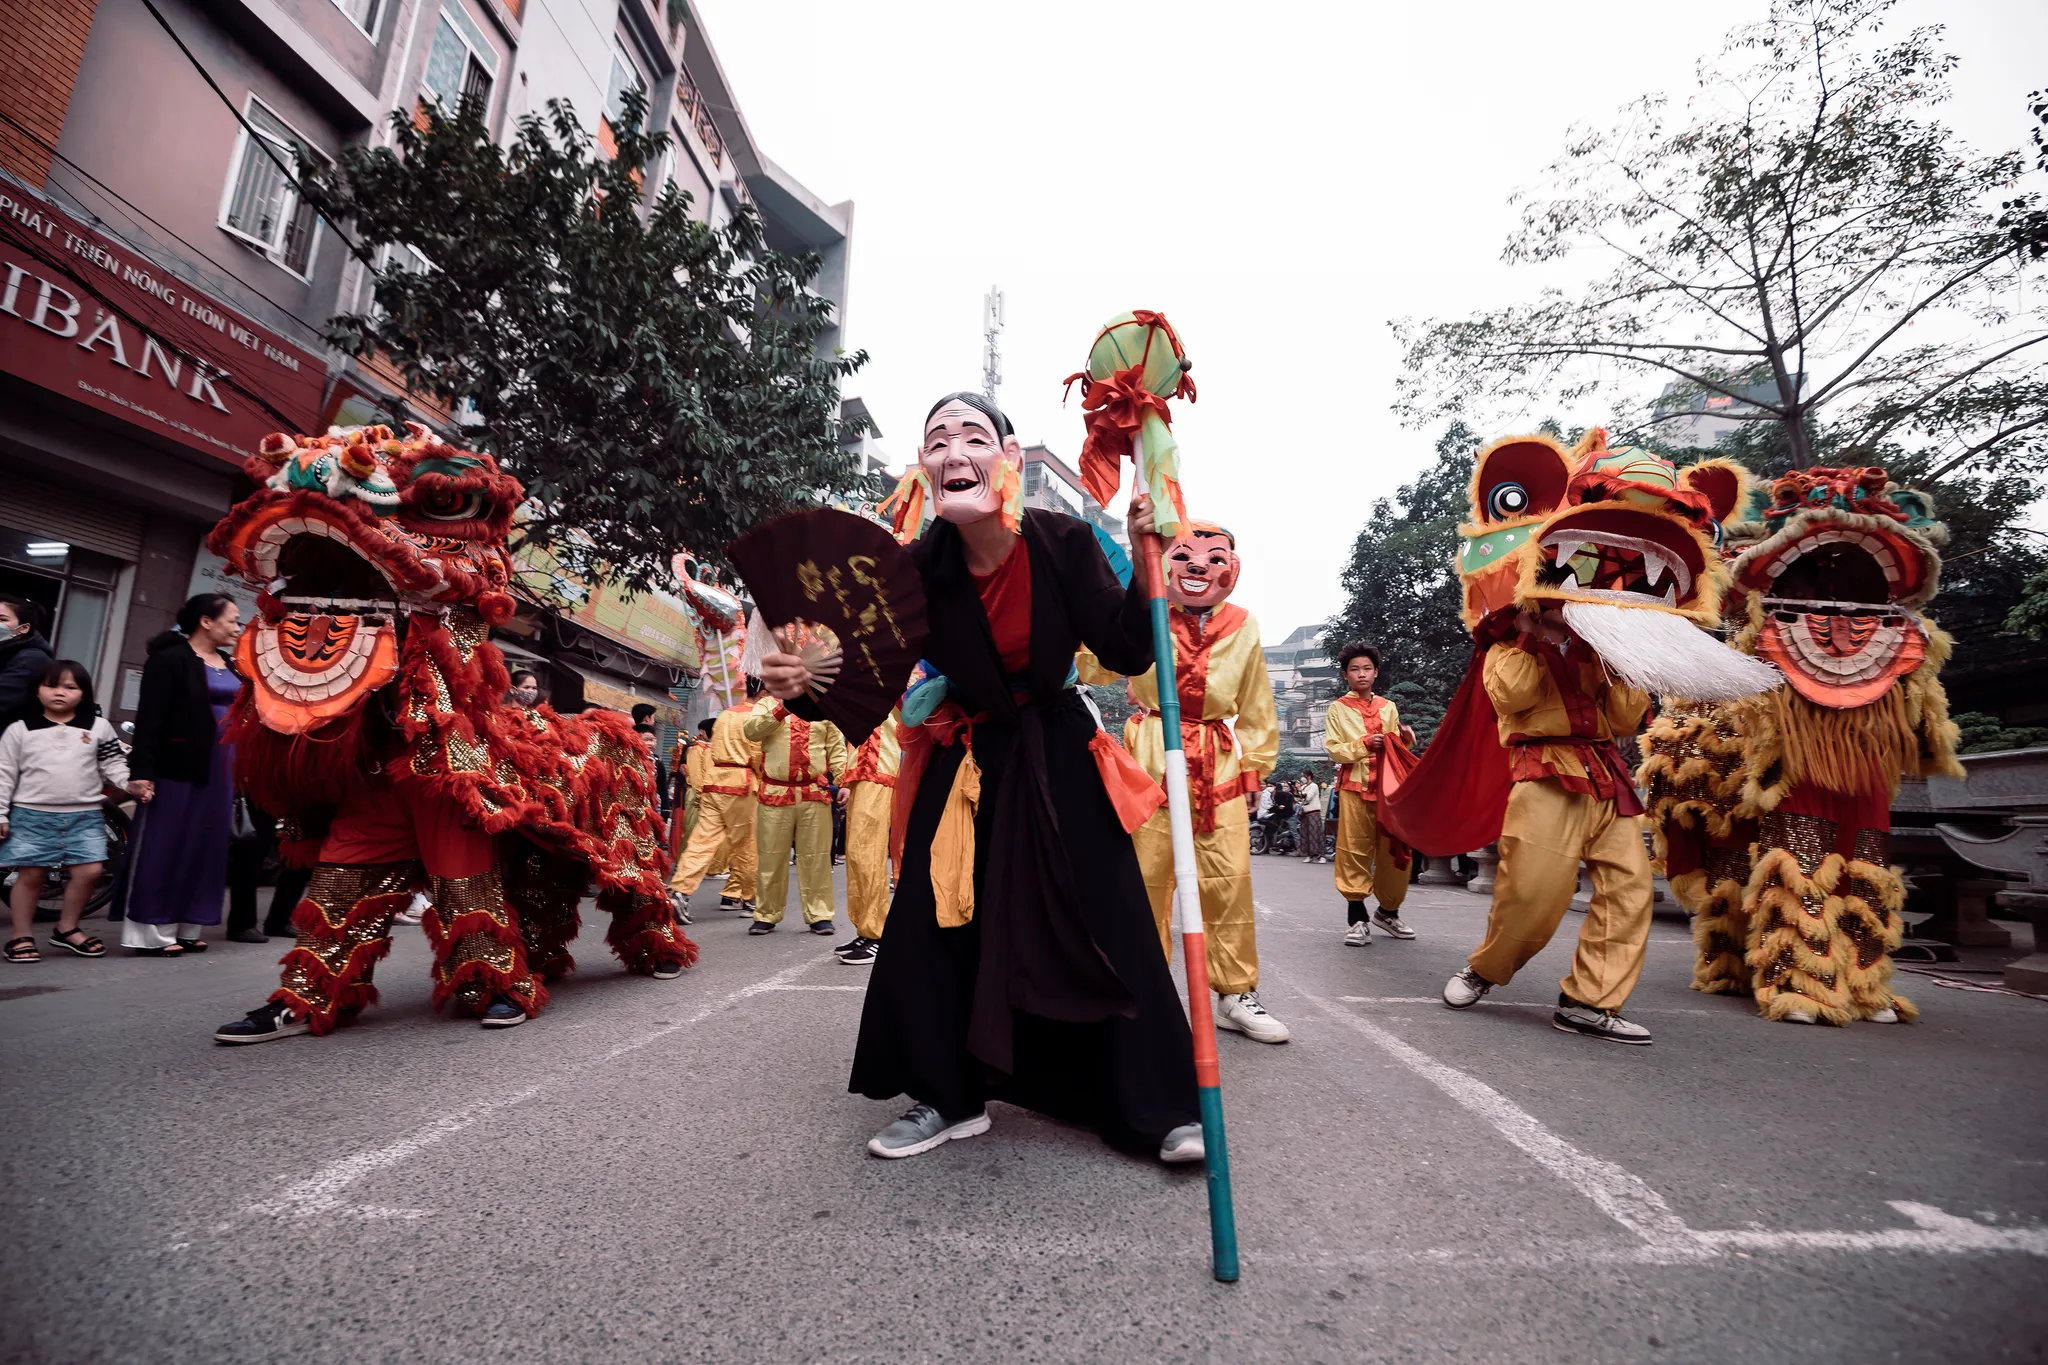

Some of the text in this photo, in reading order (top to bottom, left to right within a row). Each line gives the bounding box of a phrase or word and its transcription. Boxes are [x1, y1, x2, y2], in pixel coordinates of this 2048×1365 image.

[0, 195, 58, 239] PHÁT
[123, 265, 176, 306] NÔNG
[181, 295, 226, 333] THÔN
[229, 321, 262, 352] VIỆT
[263, 343, 300, 372] NAM
